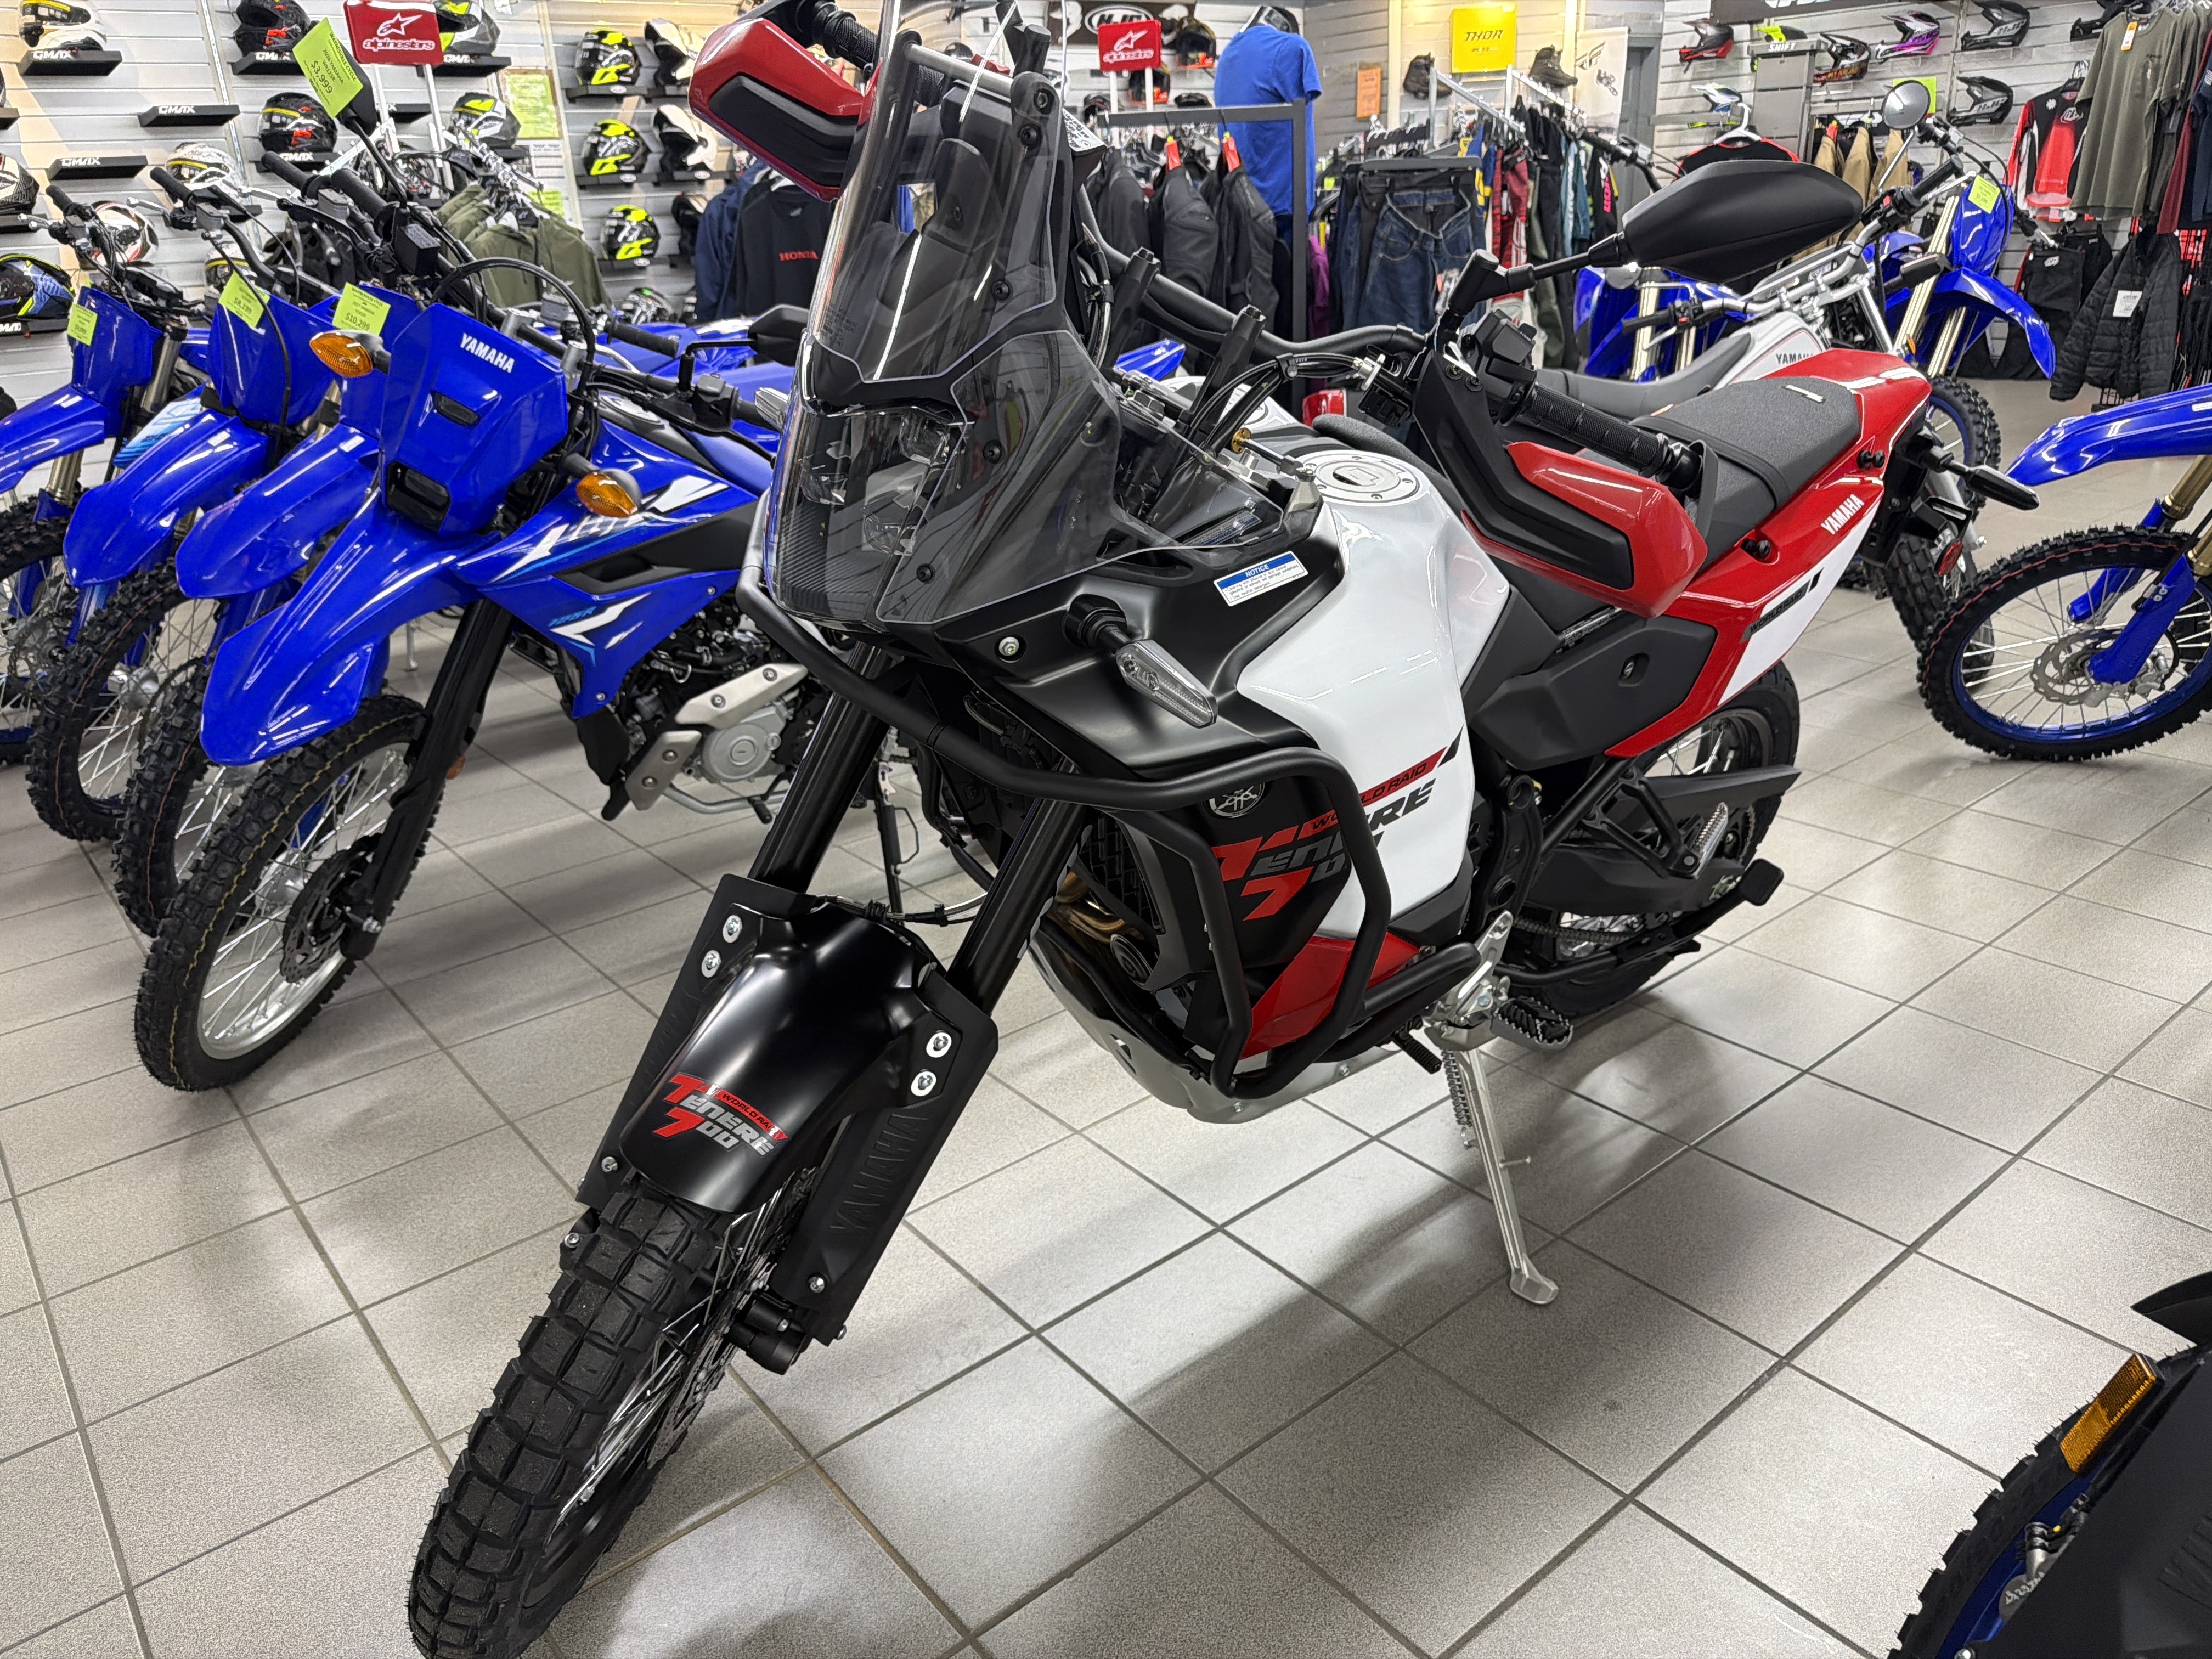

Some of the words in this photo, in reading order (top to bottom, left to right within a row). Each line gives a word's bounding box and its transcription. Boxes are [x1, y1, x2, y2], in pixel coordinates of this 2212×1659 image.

[362, 37, 436, 52] alpinestars
[1465, 30, 1503, 42] THOR
[1768, 42, 1796, 52] SHIFT
[32, 50, 74, 60] GMAX
[329, 31, 347, 67] WAYNESVILLE
[346, 65, 357, 82] CYCLE
[311, 60, 333, 94] $3,999
[330, 61, 344, 84] YAMAHA
[157, 106, 196, 114] GMAX
[60, 157, 101, 167] GMAX
[345, 312, 370, 331] $10,299
[460, 332, 515, 373] YAMAHA
[1776, 353, 1813, 365] YAMA
[1820, 494, 1865, 535] YAMAHA
[1245, 564, 1270, 578] NOTICE
[1750, 605, 1783, 633] WORLD
[1782, 590, 1802, 613] RAID
[1387, 763, 1427, 794] RAID
[722, 1093, 759, 1119] WORLD
[653, 1106, 740, 1150] 700
[830, 1113, 929, 1230] YAMAHA
